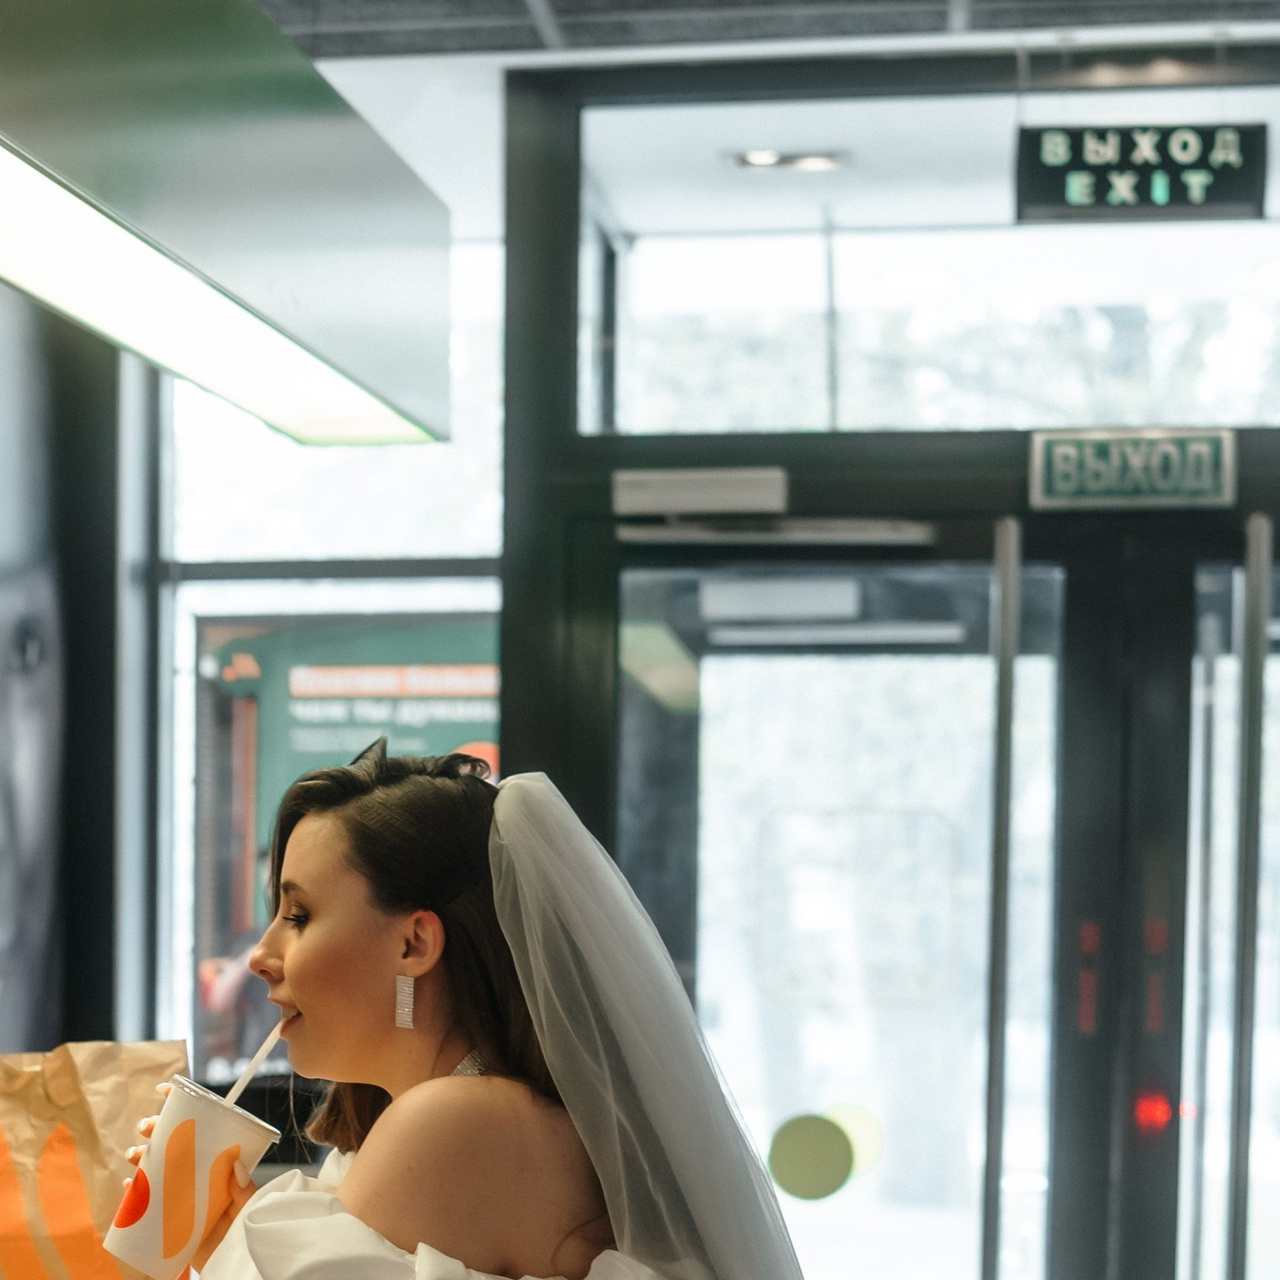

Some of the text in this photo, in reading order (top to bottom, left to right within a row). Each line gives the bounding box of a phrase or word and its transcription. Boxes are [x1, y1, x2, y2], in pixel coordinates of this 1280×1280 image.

[1040, 127, 1243, 169] ВЫХОД
[1064, 169, 1214, 206] EXIT
[1053, 440, 1214, 492] ВЫХОД
